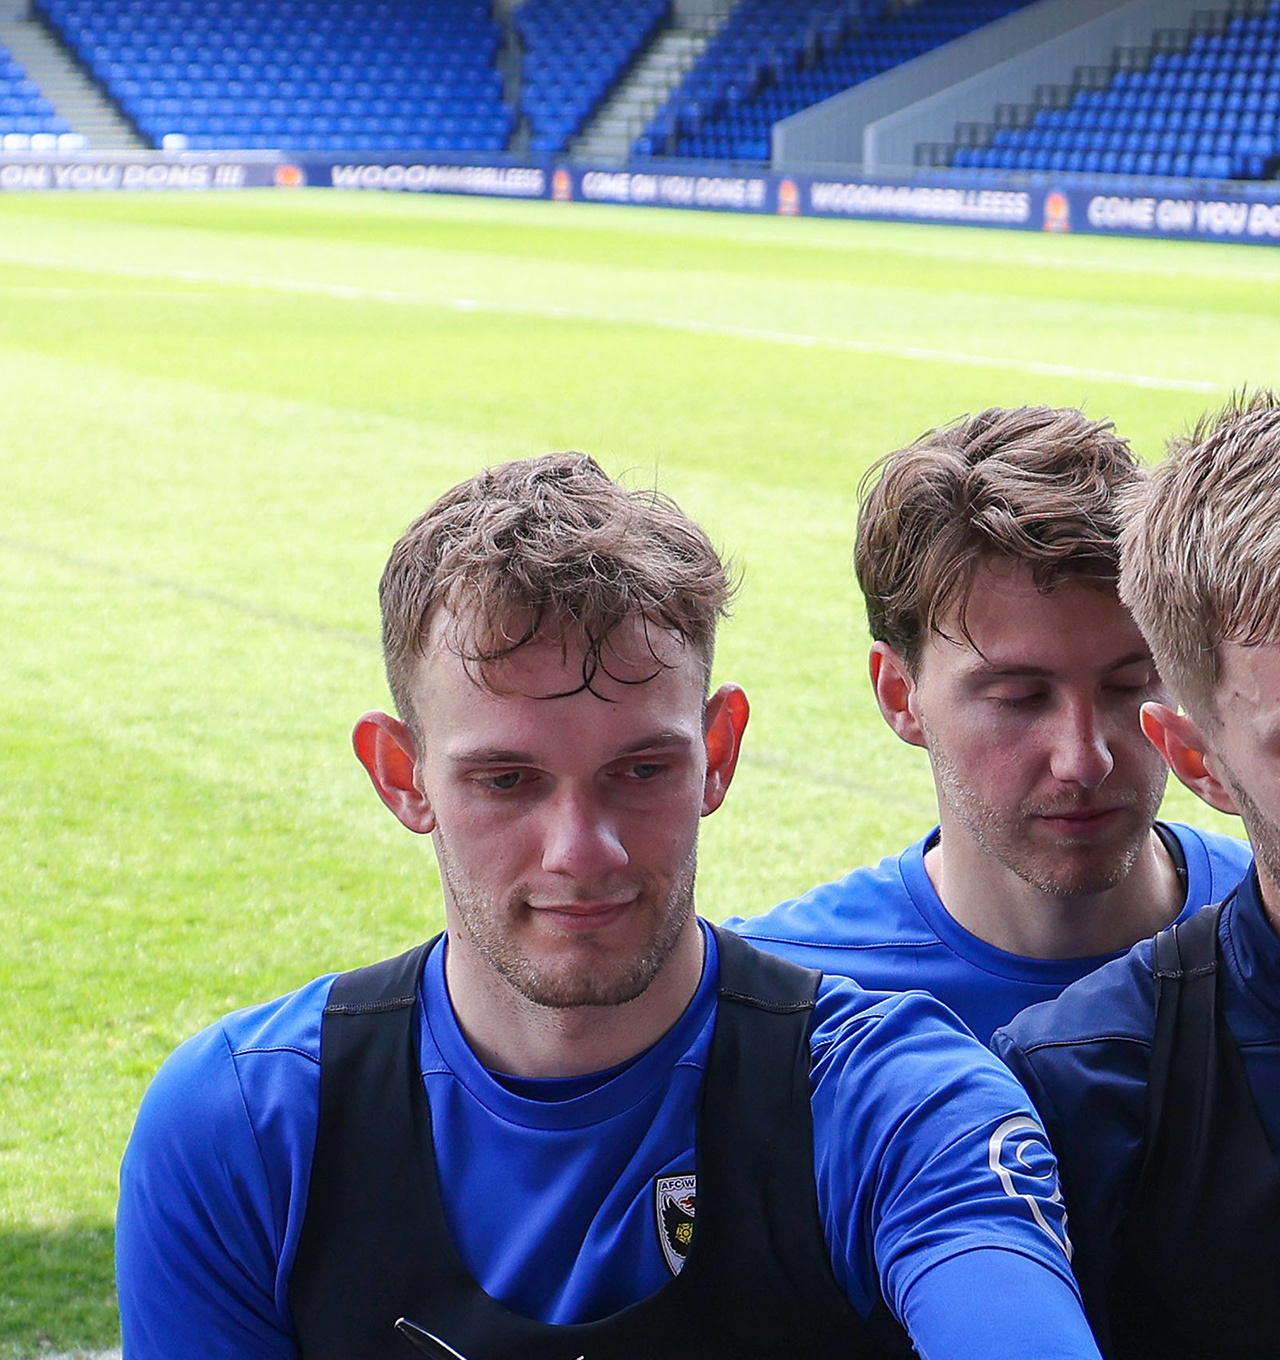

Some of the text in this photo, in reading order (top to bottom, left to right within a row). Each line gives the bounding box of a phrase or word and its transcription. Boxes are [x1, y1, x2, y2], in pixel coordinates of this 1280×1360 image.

[0, 164, 51, 189] ON
[52, 164, 120, 189] YOU
[122, 164, 213, 190] DONS
[214, 164, 245, 189] !!!
[581, 171, 631, 201] COME
[630, 174, 658, 202] ON
[658, 175, 695, 205] YOU
[695, 177, 746, 207] DONS
[1088, 195, 1156, 229] COME
[1156, 198, 1195, 232] ON
[1196, 201, 1248, 234] YOU
[660, 1179, 682, 1191] AFC
